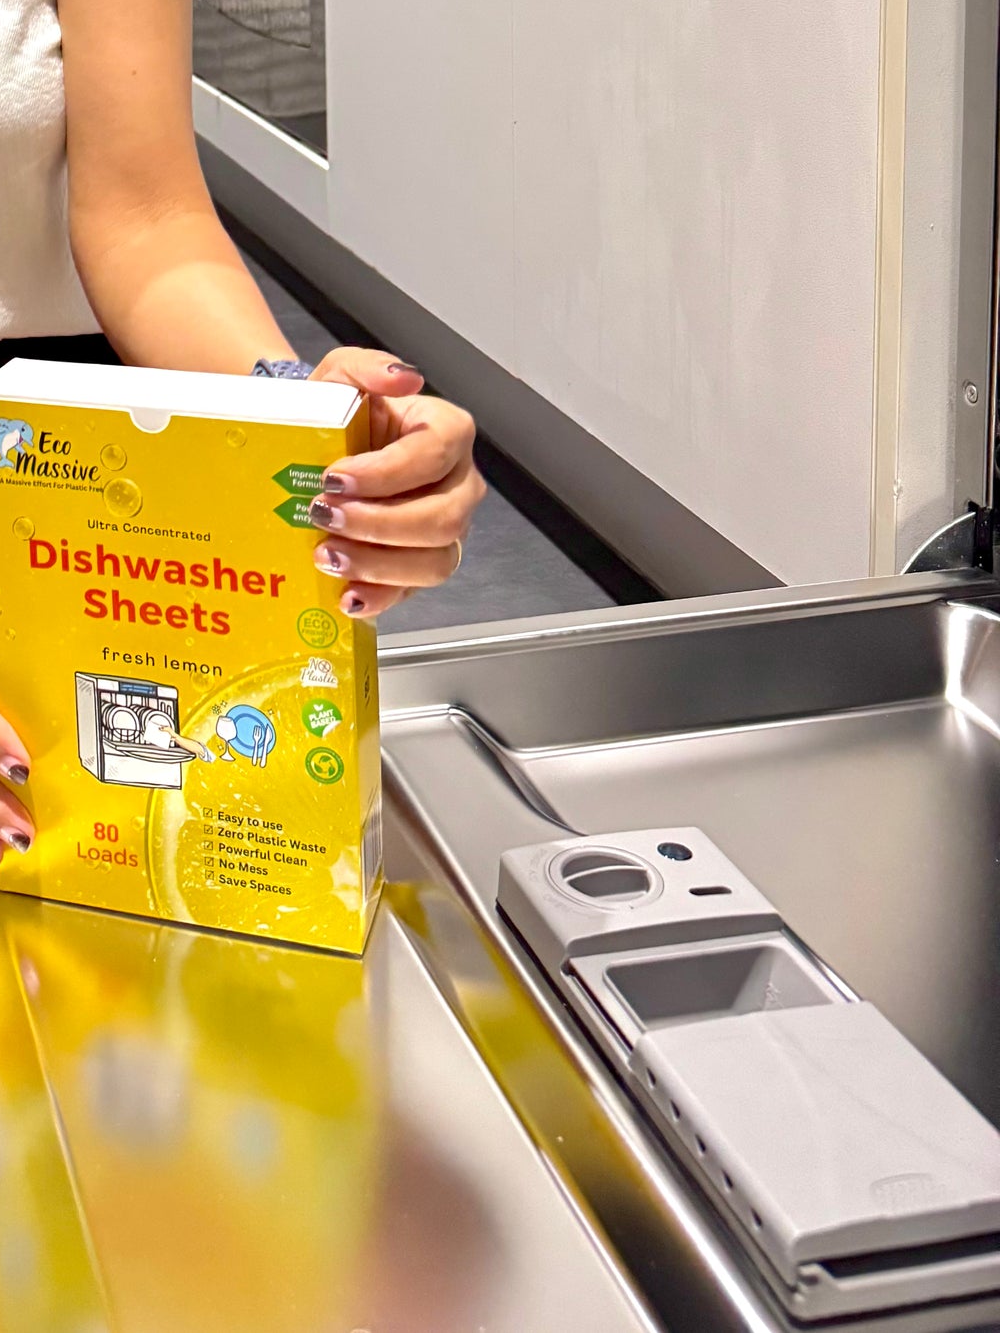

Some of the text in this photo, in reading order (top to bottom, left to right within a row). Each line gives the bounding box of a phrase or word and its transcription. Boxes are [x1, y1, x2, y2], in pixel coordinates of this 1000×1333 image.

[38, 431, 72, 455] Eco
[15, 451, 101, 482] Massive
[5, 478, 32, 487] Massive
[33, 480, 52, 489] Effort
[53, 481, 64, 490] For
[65, 483, 88, 492] Plastic
[292, 478, 323, 489] Formul
[87, 519, 211, 542] Ultra Concentrated
[28, 538, 286, 598] Dishwasher
[83, 588, 231, 636] Sheets
[303, 618, 331, 630] ECO
[102, 646, 223, 677] fresh lemon
[301, 669, 338, 685] Plastic
[308, 708, 334, 722] PLANT
[310, 716, 336, 729] BASED
[217, 811, 283, 831] Easy to use
[93, 822, 119, 843] 80
[217, 826, 327, 854] Zero Plastic Waste
[77, 841, 138, 868] Loads
[218, 842, 308, 867] Powerful Clean
[218, 858, 269, 876] No Mess
[218, 874, 292, 896] Save Spaces
